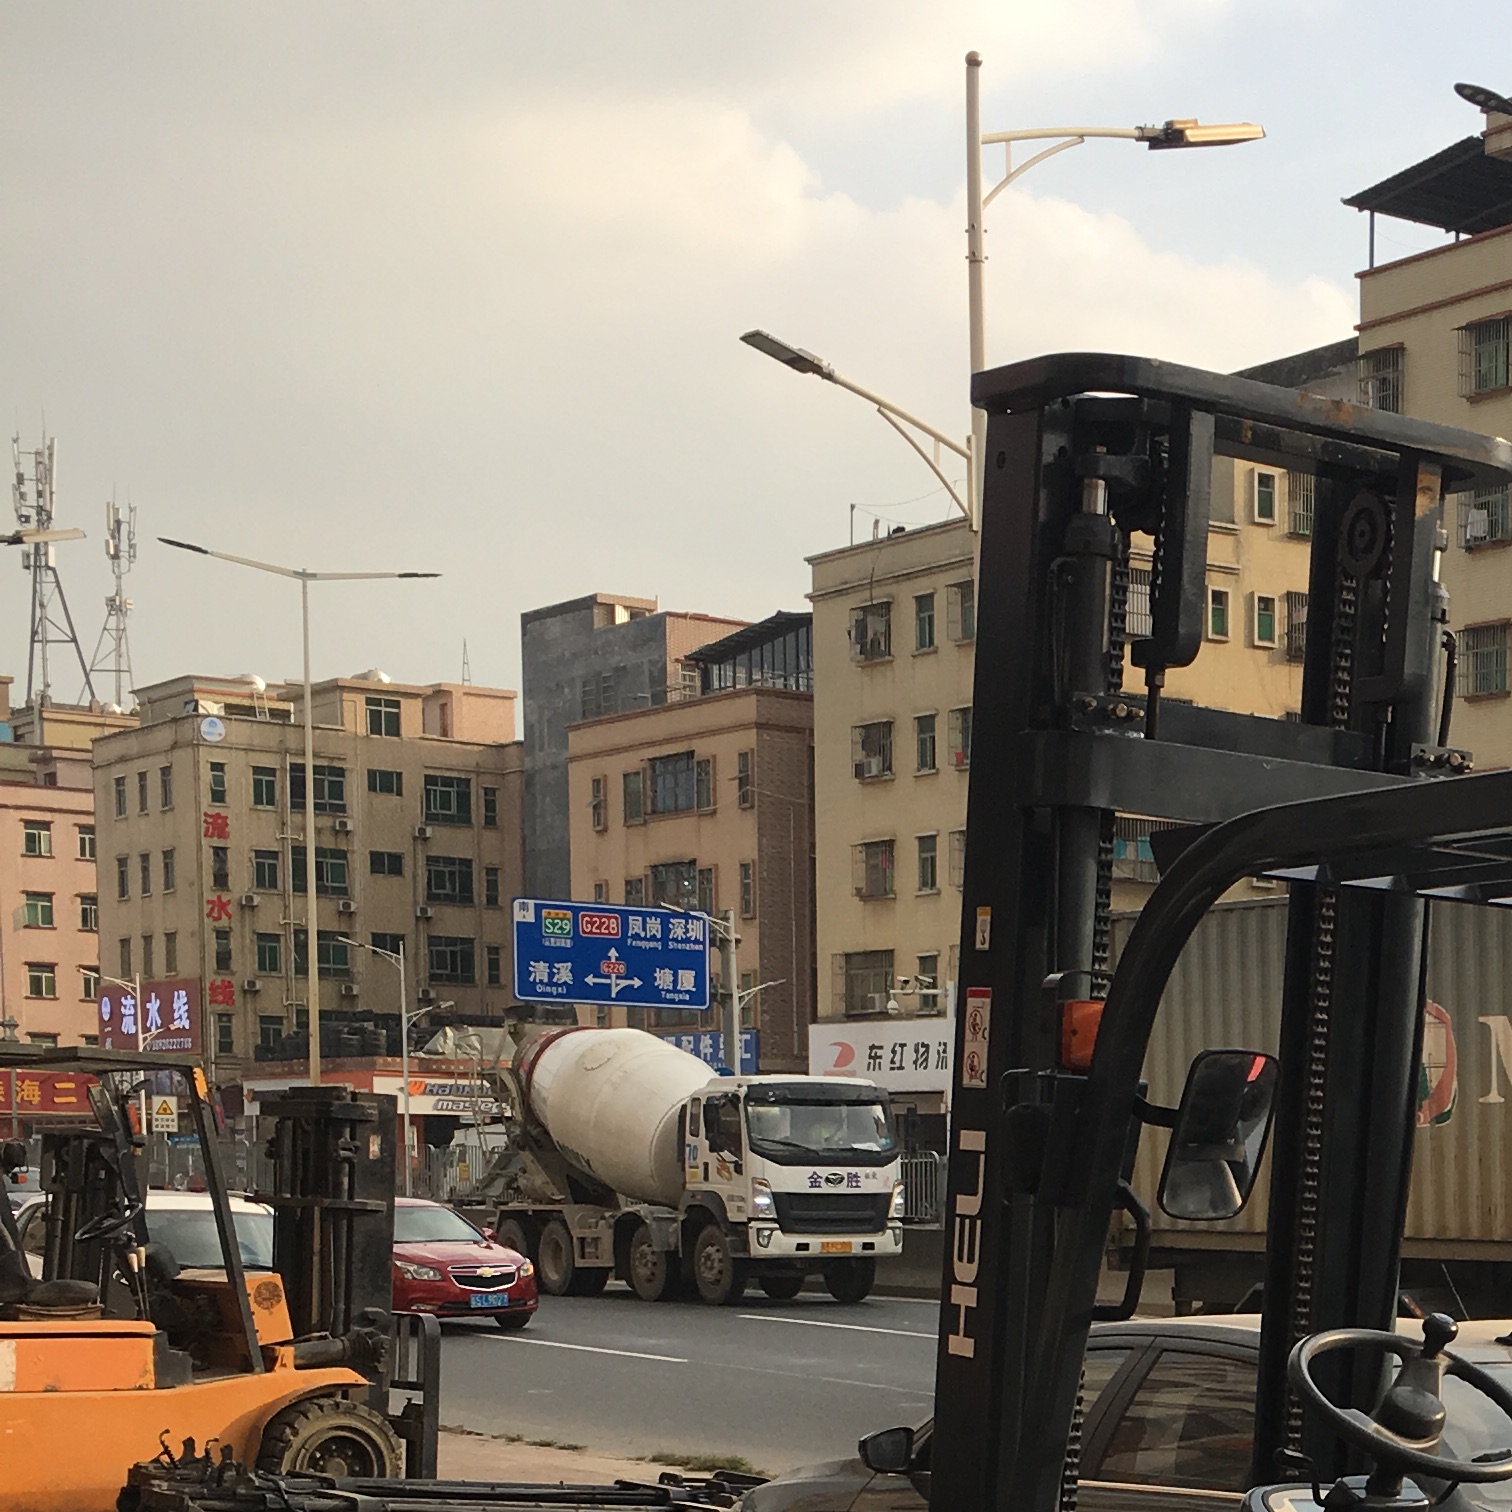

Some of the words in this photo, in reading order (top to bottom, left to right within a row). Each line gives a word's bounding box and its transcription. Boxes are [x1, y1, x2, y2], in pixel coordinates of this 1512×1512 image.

[203, 811, 235, 1007] 流水线
[545, 918, 571, 934] S29
[582, 916, 618, 934] G228
[627, 915, 662, 939] 凤岗
[668, 918, 704, 941] 深圳
[528, 960, 574, 985] 清溪
[0, 1080, 77, 1104] 海二
[437, 1100, 510, 1114] masers
[948, 1130, 986, 1358] HELI
